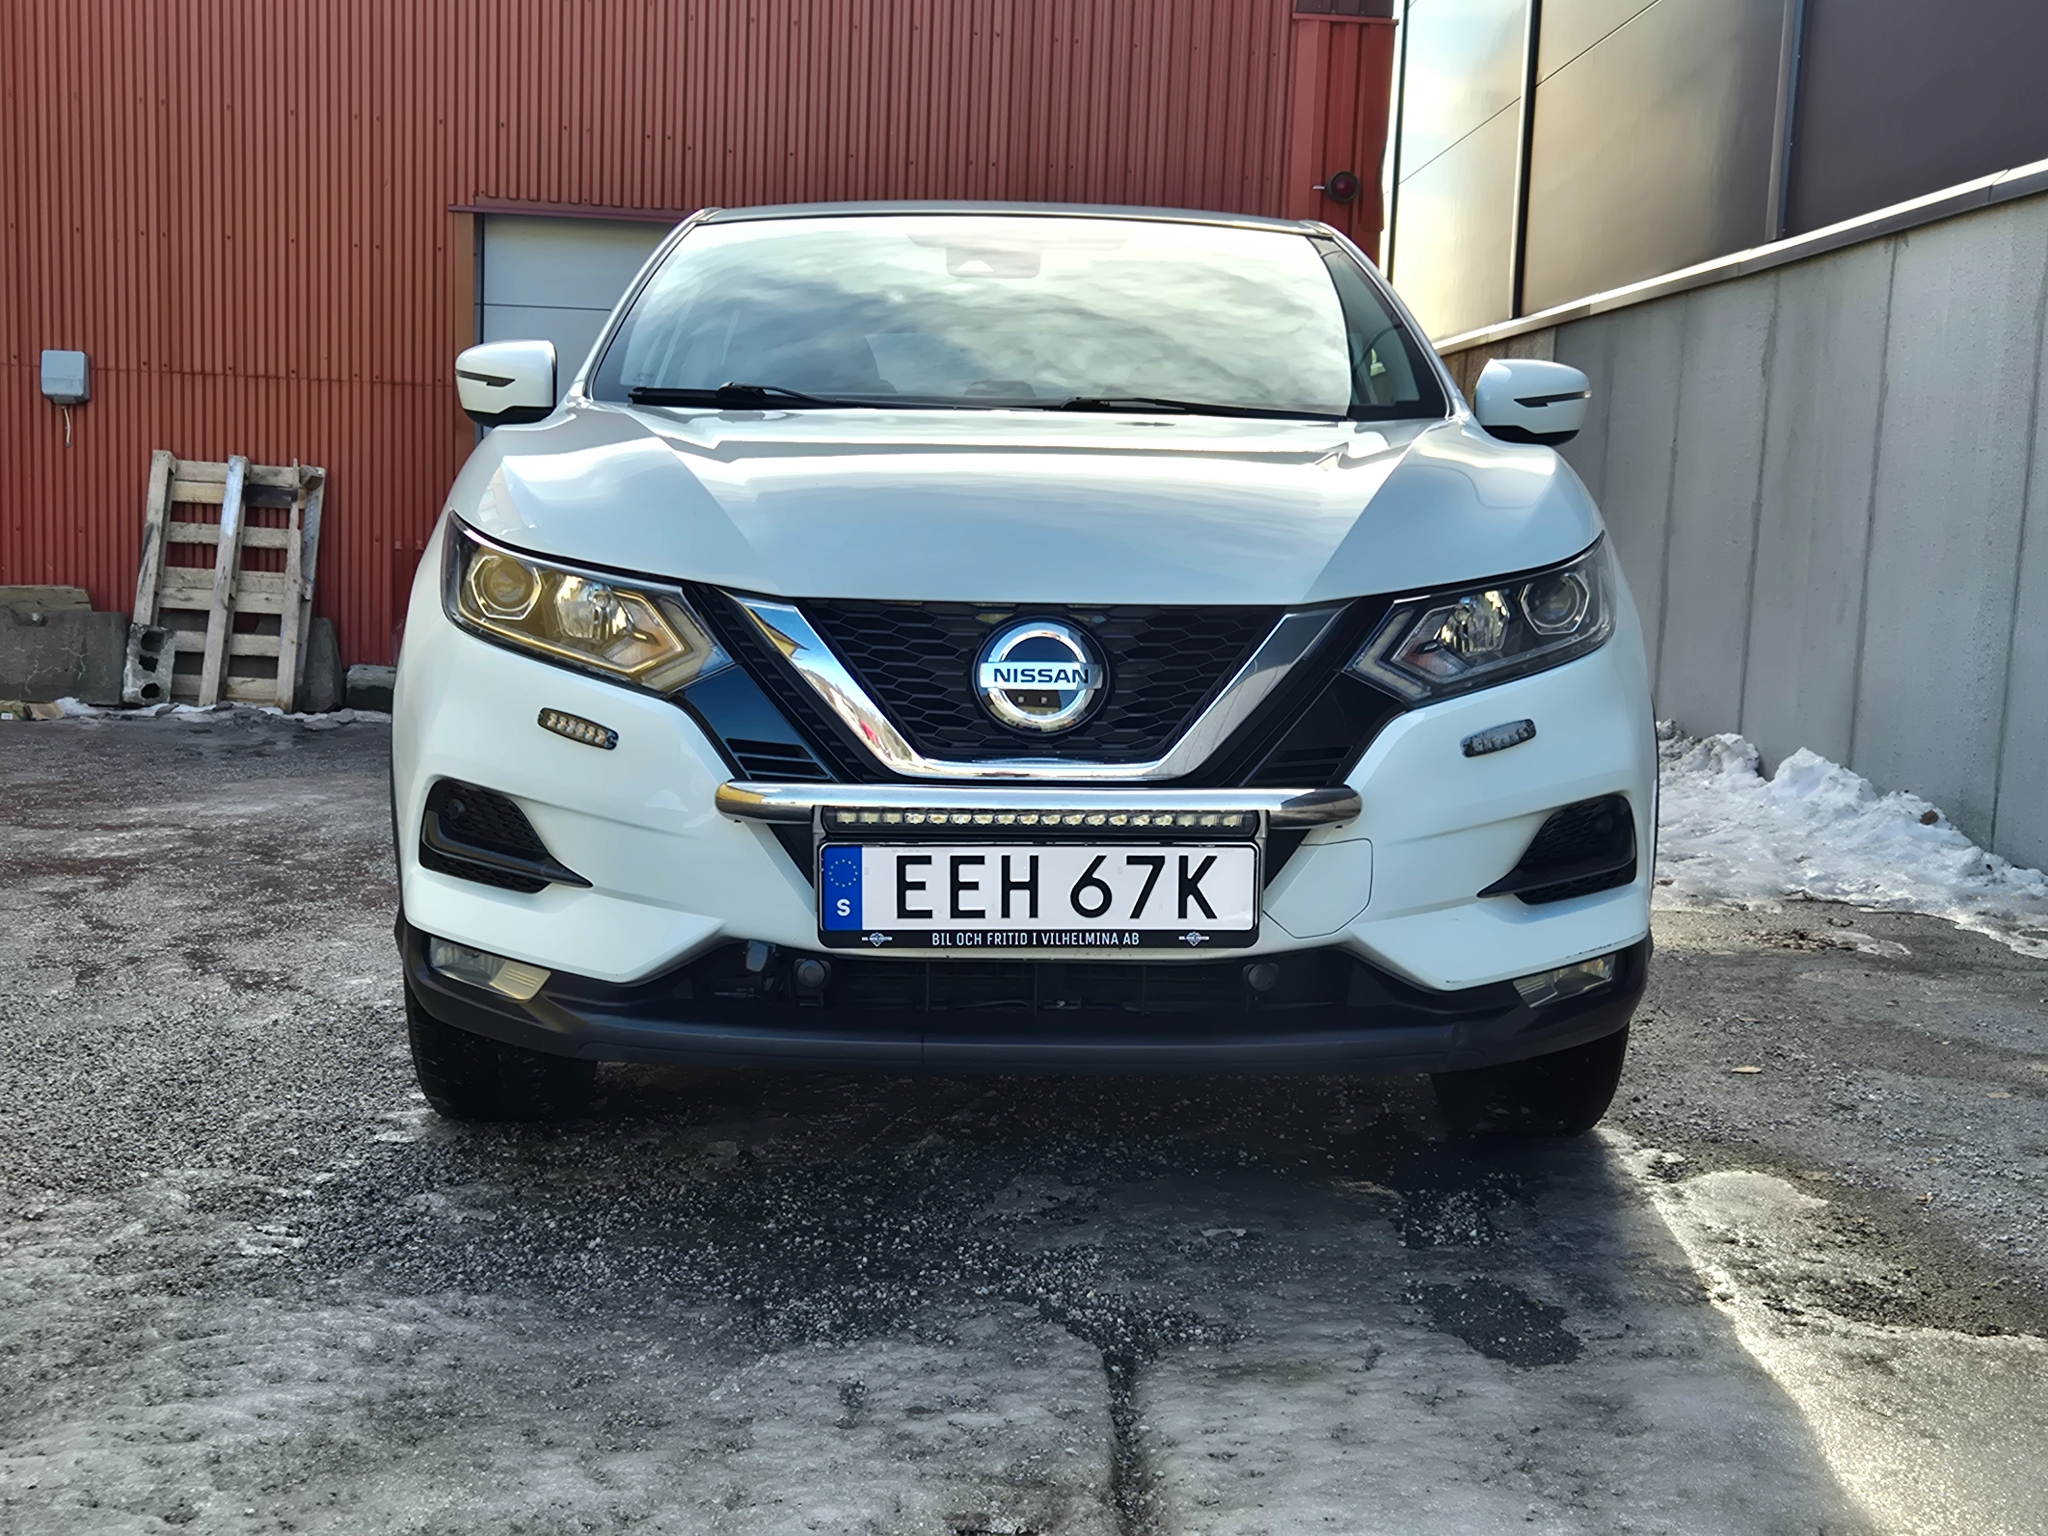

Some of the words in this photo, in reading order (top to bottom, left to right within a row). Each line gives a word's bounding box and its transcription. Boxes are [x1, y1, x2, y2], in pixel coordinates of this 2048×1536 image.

[994, 668, 1089, 684] NISSAN
[896, 855, 1039, 919] EEH
[1070, 855, 1218, 919] 67K
[837, 899, 850, 917] S
[932, 932, 952, 946] BIL
[956, 932, 982, 946] OCH
[987, 932, 1028, 946] FRITID
[1040, 932, 1119, 946] VILHELMINA
[1122, 932, 1140, 946] AB
